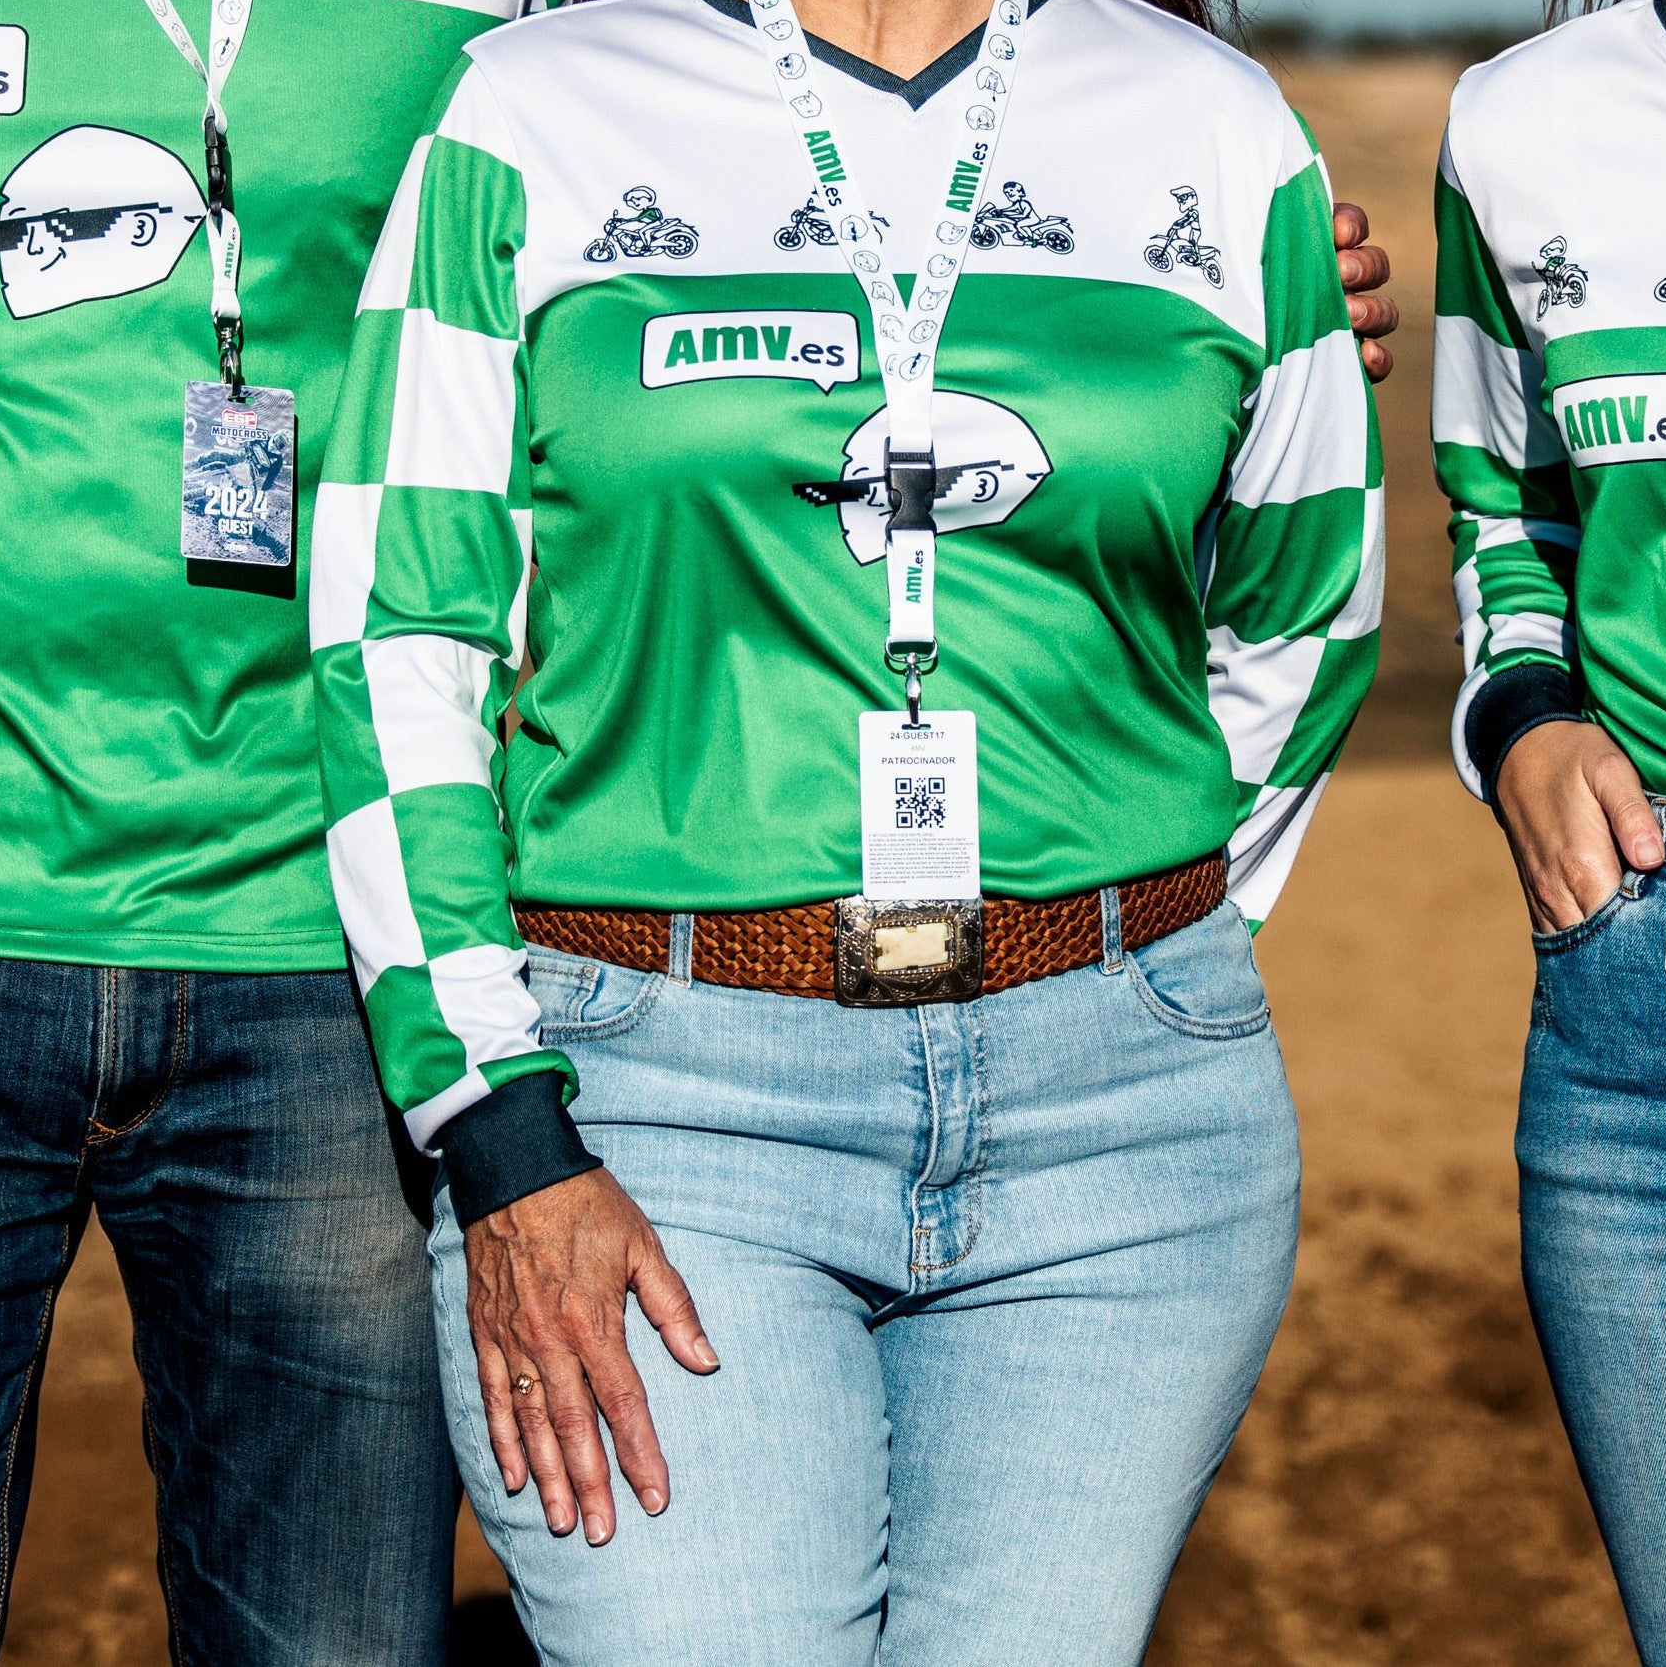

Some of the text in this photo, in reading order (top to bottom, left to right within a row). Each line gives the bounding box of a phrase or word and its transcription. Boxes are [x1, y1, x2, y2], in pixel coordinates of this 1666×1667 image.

[212, 426, 268, 440] MOTOCROSS
[204, 486, 269, 519] 2024
[218, 520, 254, 535] GUEST
[880, 756, 956, 766] PATROCINADOR
